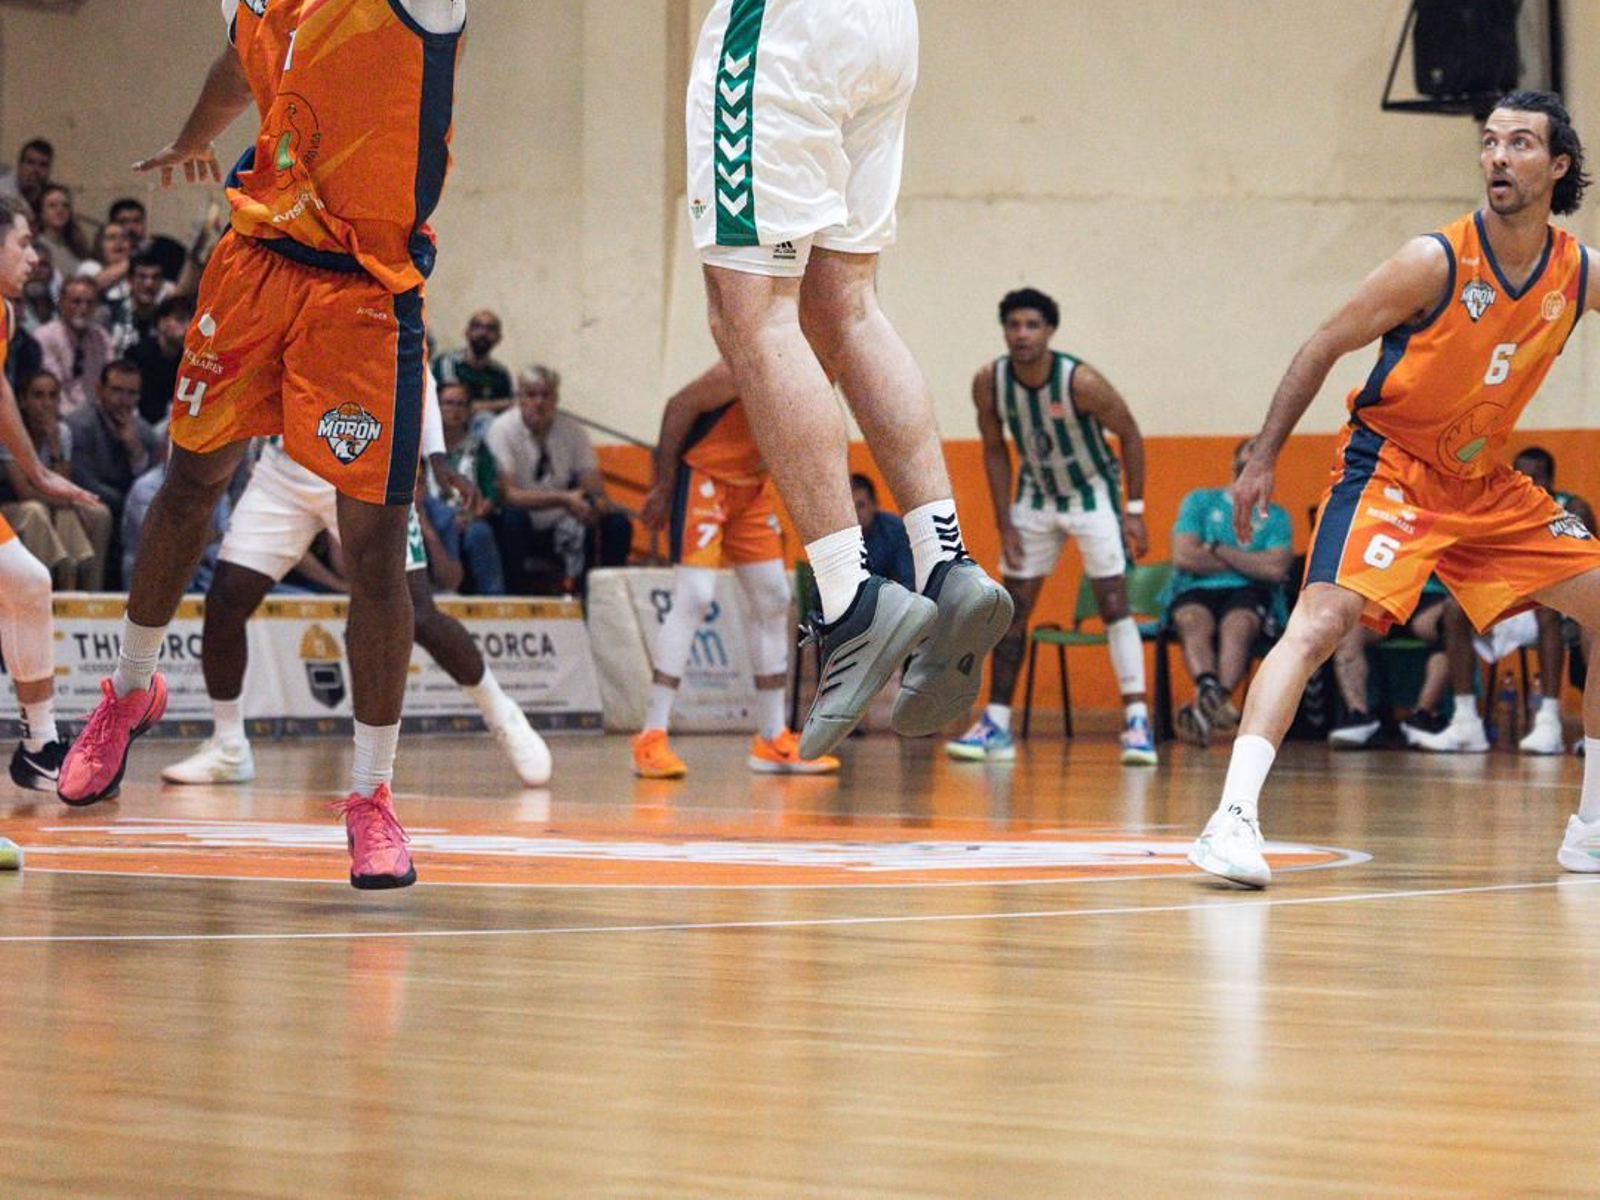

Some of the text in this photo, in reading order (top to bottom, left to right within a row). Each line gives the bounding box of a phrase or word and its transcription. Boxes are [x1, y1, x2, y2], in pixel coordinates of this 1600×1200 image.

[1483, 342, 1518, 386] 6
[177, 375, 208, 417] 4
[317, 419, 382, 441] MORON
[696, 522, 719, 549] 7
[1363, 533, 1401, 570] 6
